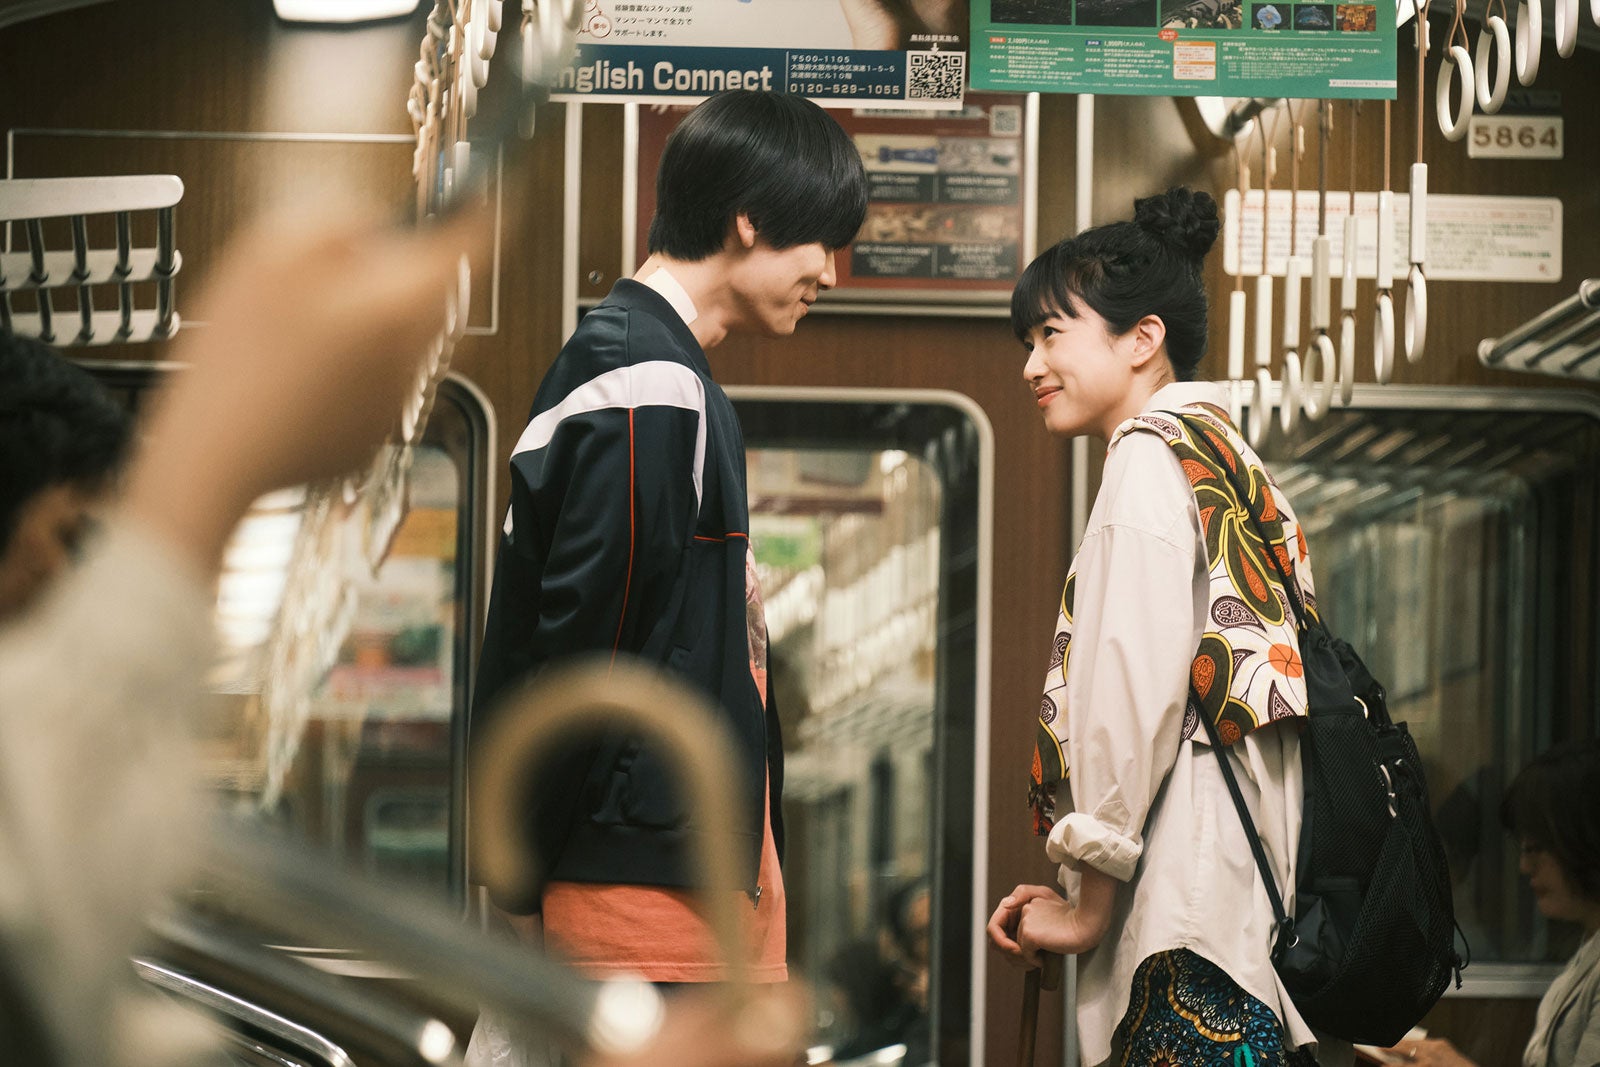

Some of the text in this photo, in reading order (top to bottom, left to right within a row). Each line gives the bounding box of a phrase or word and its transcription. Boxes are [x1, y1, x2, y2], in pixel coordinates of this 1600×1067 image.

[614, 16, 693, 26] マンツーマンで全力で
[614, 29, 667, 37] サポートします。
[653, 60, 773, 92] Connect
[789, 83, 901, 95] 0120-529-1055
[1474, 125, 1558, 149] 5864
